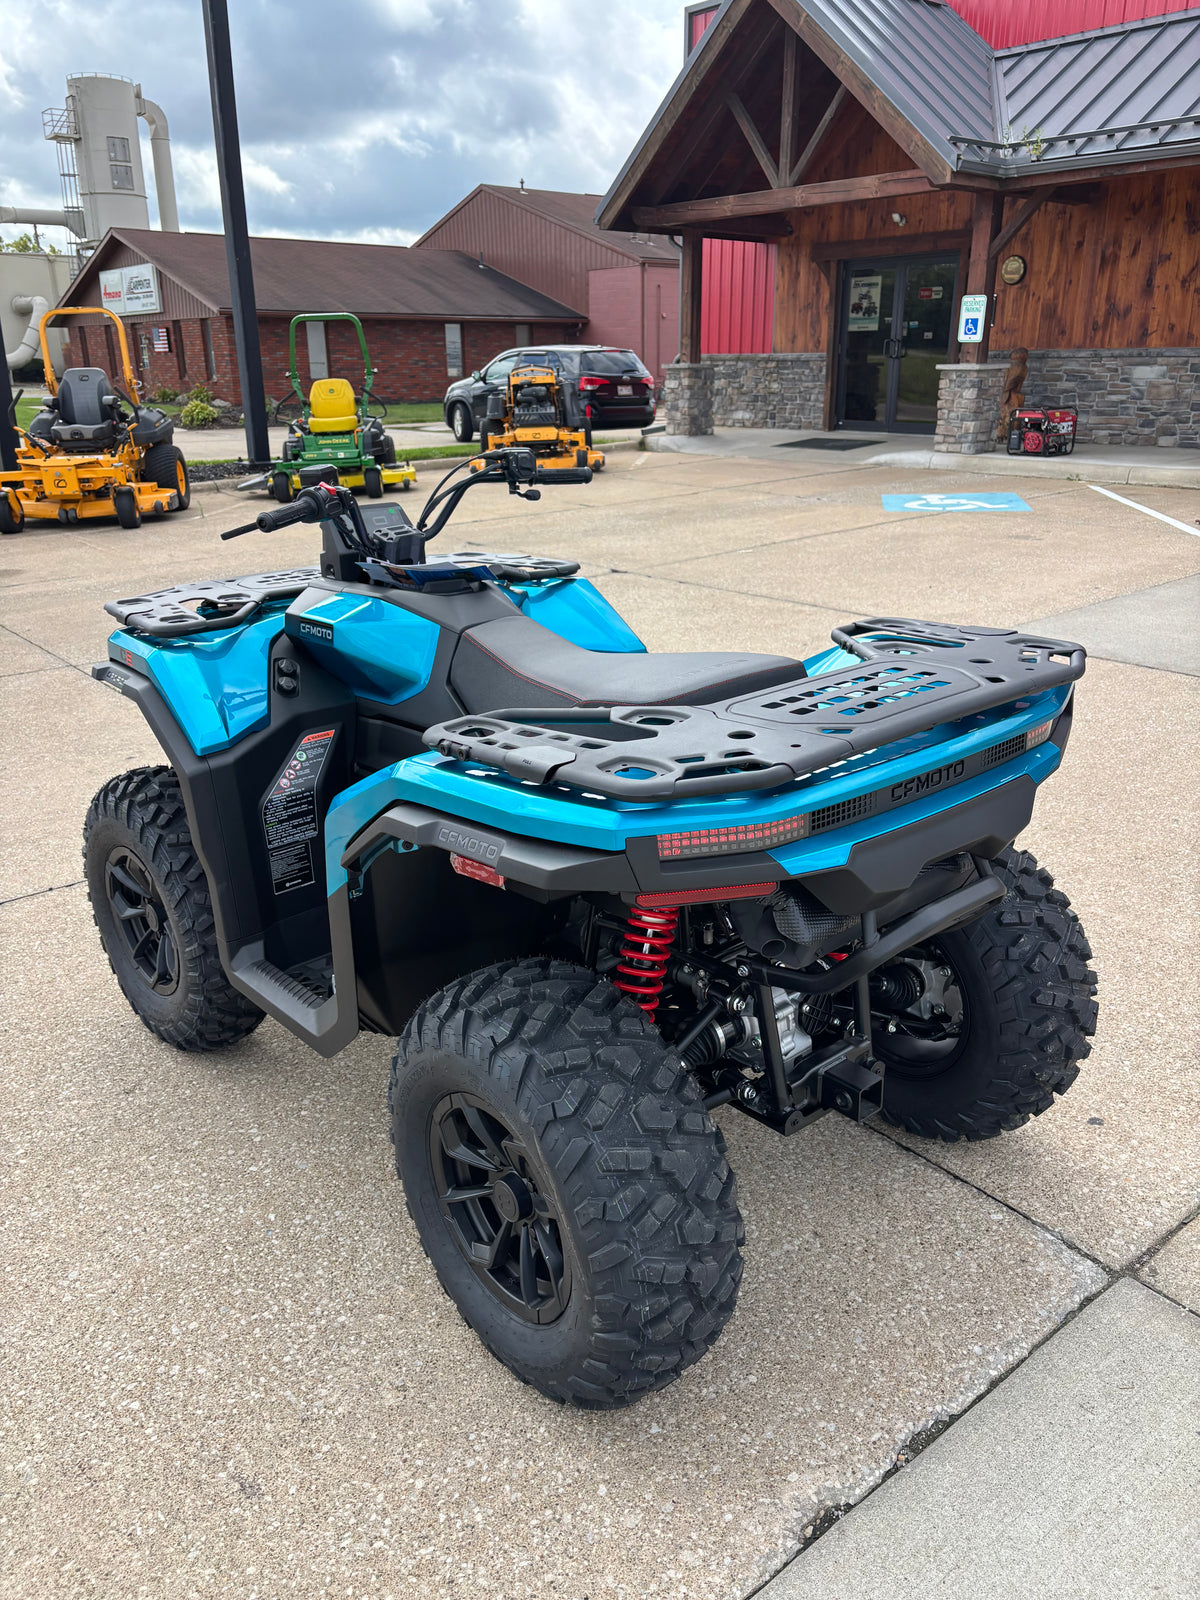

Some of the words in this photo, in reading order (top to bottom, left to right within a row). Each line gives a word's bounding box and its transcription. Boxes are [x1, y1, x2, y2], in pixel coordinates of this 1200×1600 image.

[300, 623, 332, 640] CFMOTO
[891, 760, 965, 802] CFMOTO
[438, 828, 498, 860] CFMOTO
